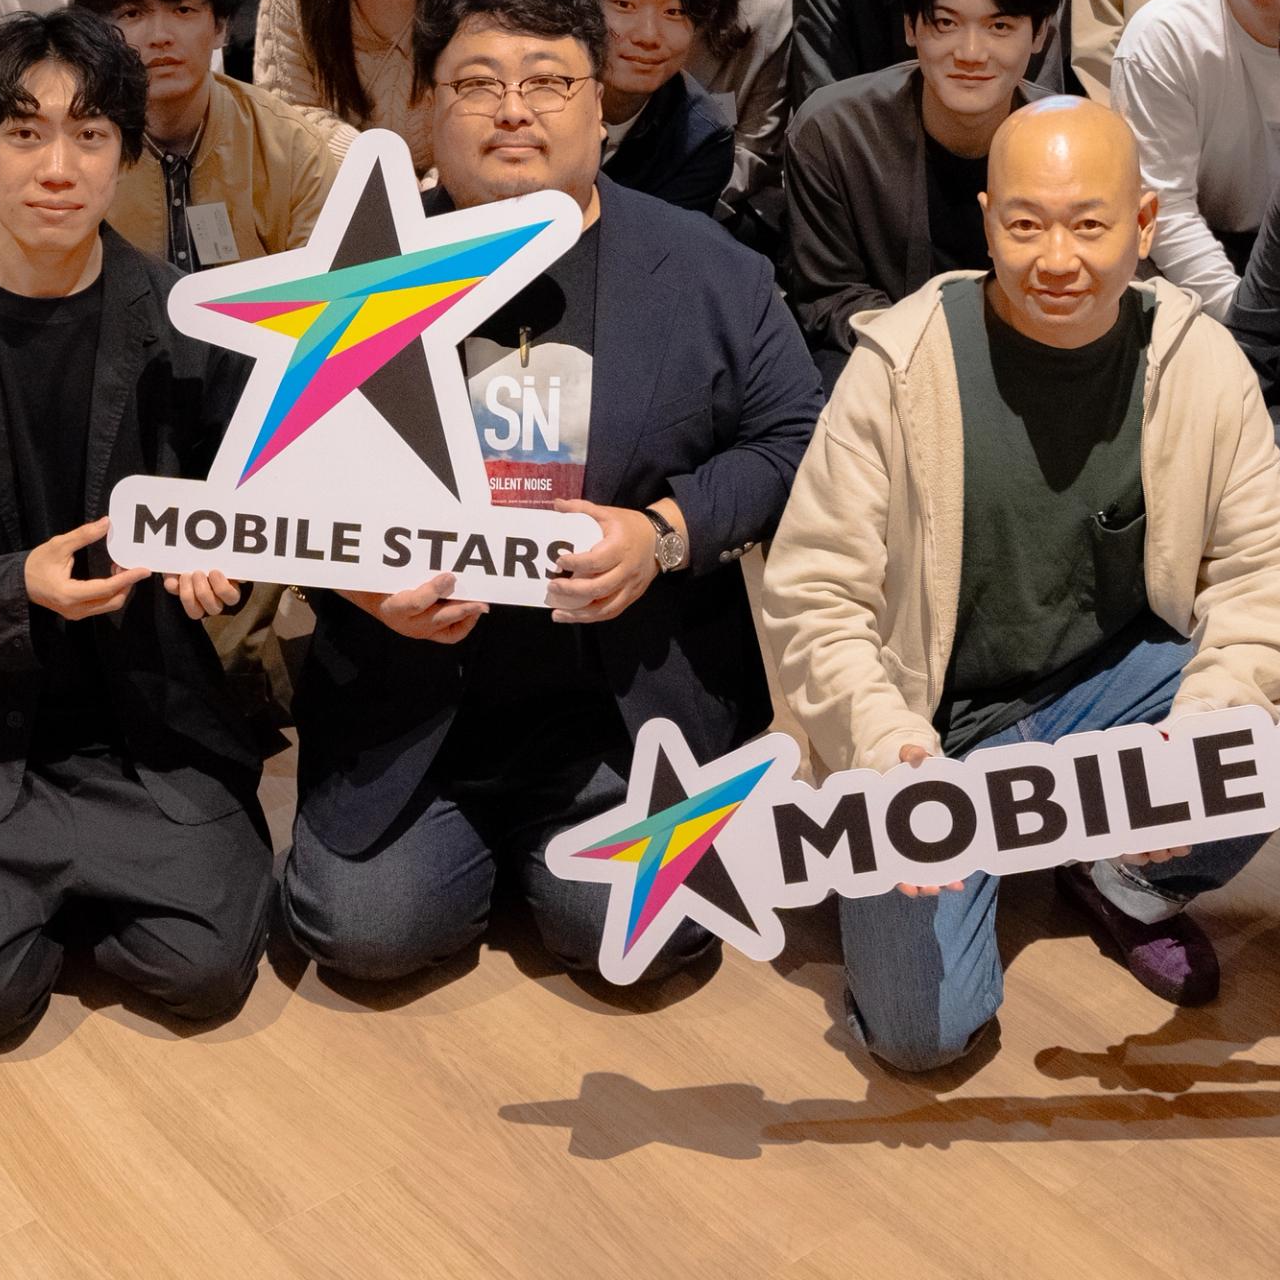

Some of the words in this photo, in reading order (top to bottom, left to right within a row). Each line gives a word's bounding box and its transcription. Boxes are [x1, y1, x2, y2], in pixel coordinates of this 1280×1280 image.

[489, 477, 523, 490] SILENT
[524, 478, 553, 491] NOISE
[132, 504, 363, 565] MOBILE
[382, 526, 575, 580] STARS
[772, 728, 1265, 885] MOBILE
